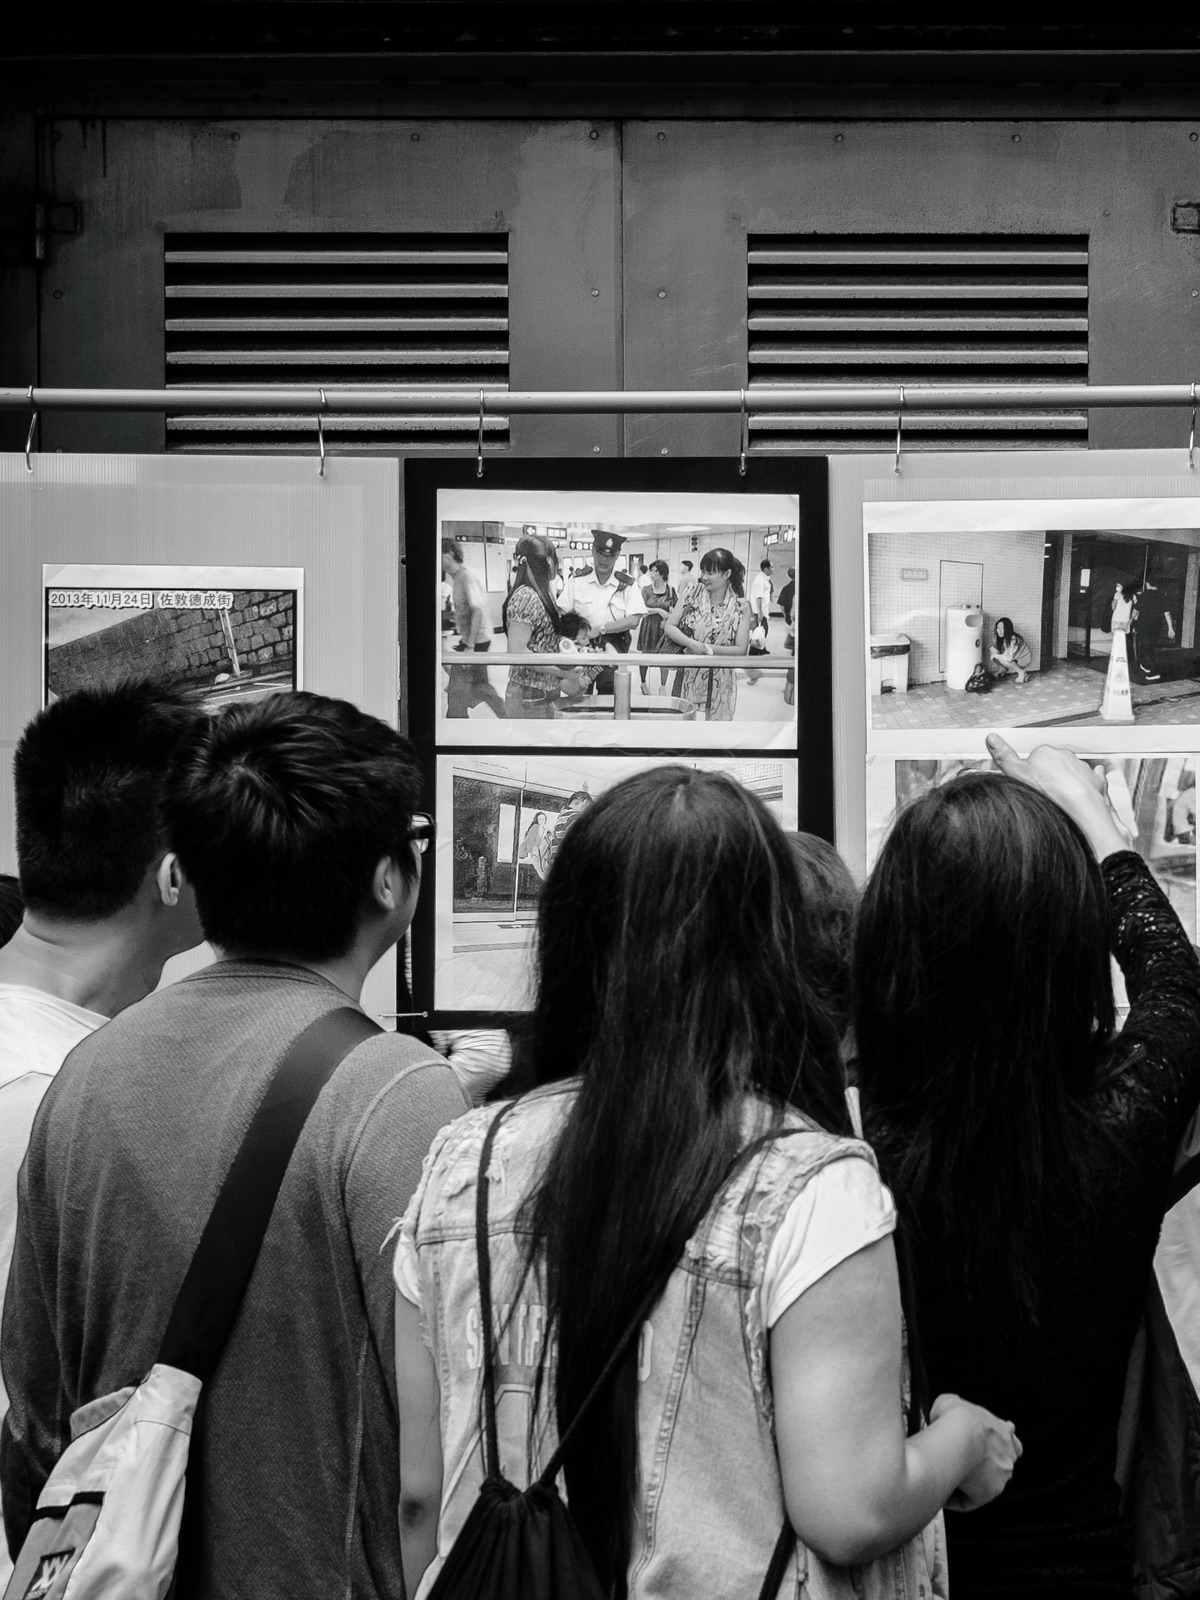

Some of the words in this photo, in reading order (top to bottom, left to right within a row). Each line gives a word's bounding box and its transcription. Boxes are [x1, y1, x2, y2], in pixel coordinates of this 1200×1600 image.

[50, 592, 151, 606] 2013年11月24日
[159, 592, 232, 607] 佐敦德成街
